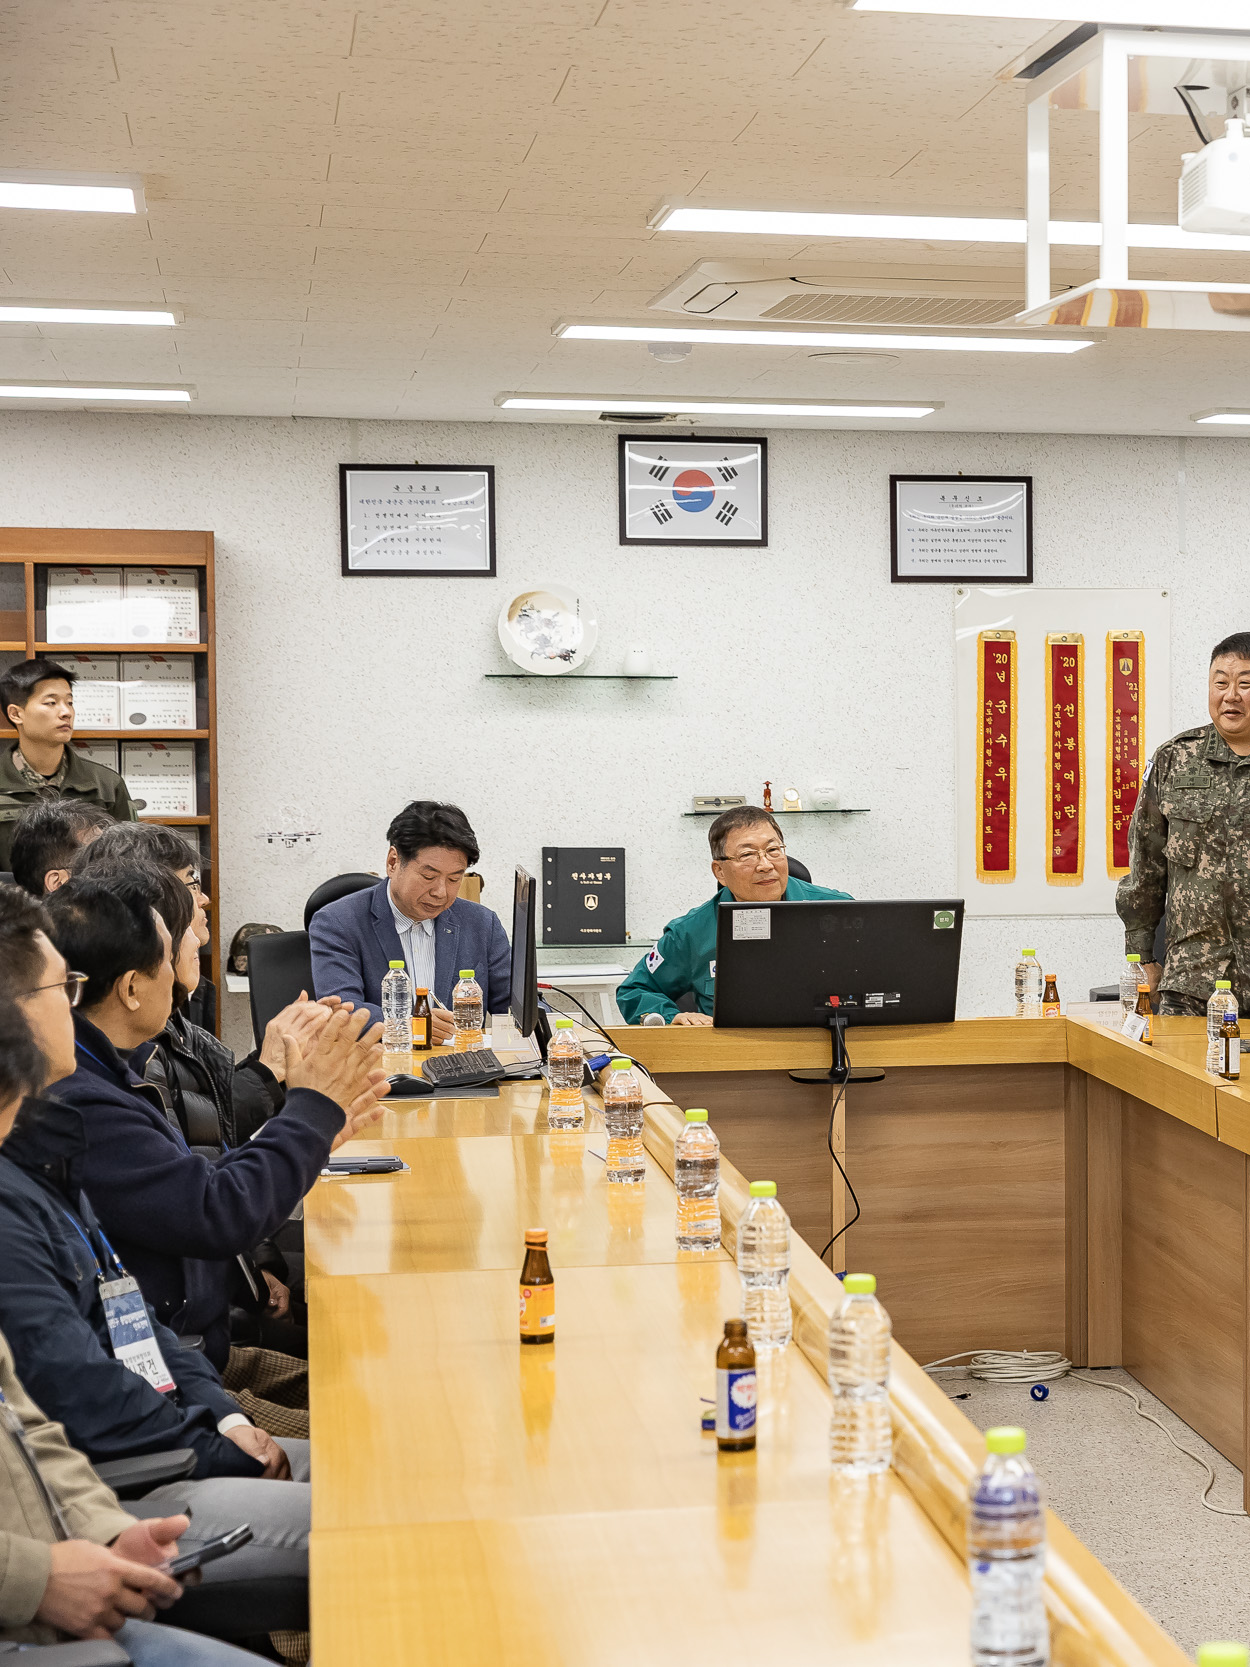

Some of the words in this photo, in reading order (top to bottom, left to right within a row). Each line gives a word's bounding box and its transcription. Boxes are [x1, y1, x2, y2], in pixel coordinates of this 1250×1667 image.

[985, 700, 993, 767] 수도방위사령관
[994, 700, 1008, 815] 군수우수
[1053, 703, 1062, 770] 수도방위사령관
[1063, 703, 1077, 819] 선봉여단
[984, 779, 993, 799] 중장
[1053, 783, 1062, 802] 중장
[843, 916, 864, 930] LG
